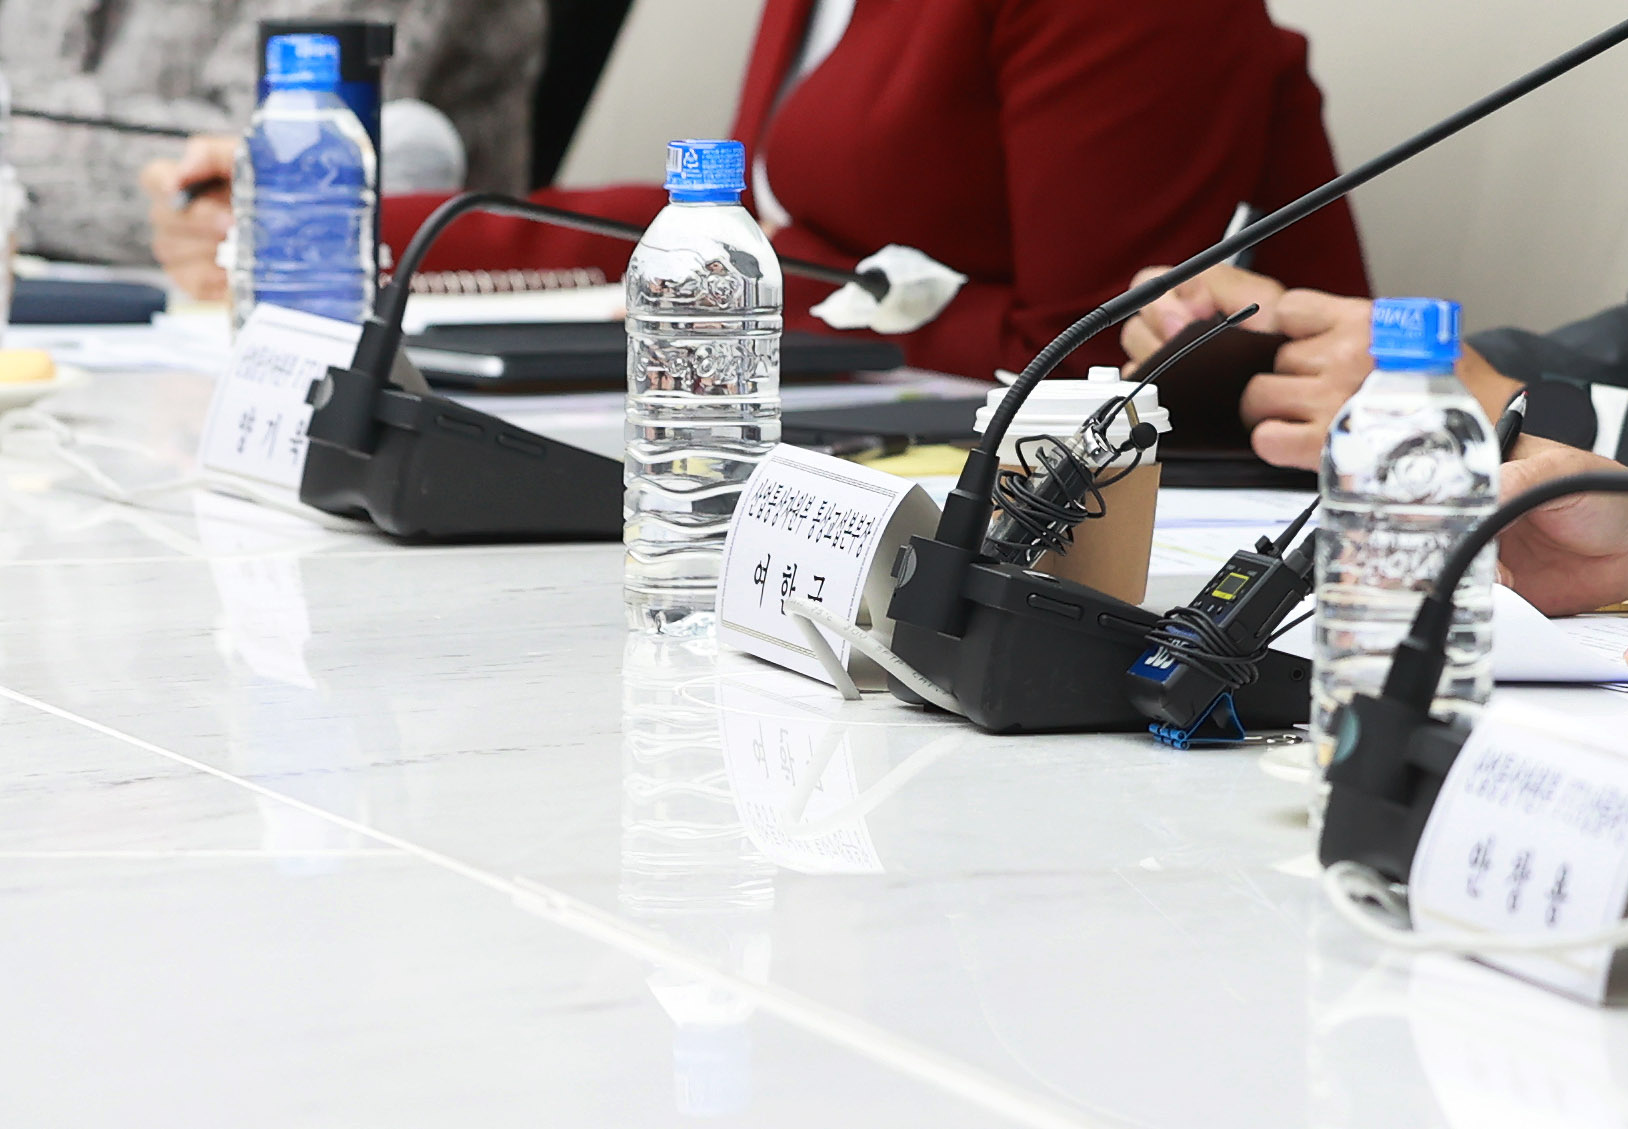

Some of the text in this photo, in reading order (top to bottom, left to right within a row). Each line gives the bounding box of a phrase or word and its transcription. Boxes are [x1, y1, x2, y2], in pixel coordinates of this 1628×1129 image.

[748, 478, 876, 558] 산업통상자원부 통상교섭본부장
[754, 553, 771, 608] 여
